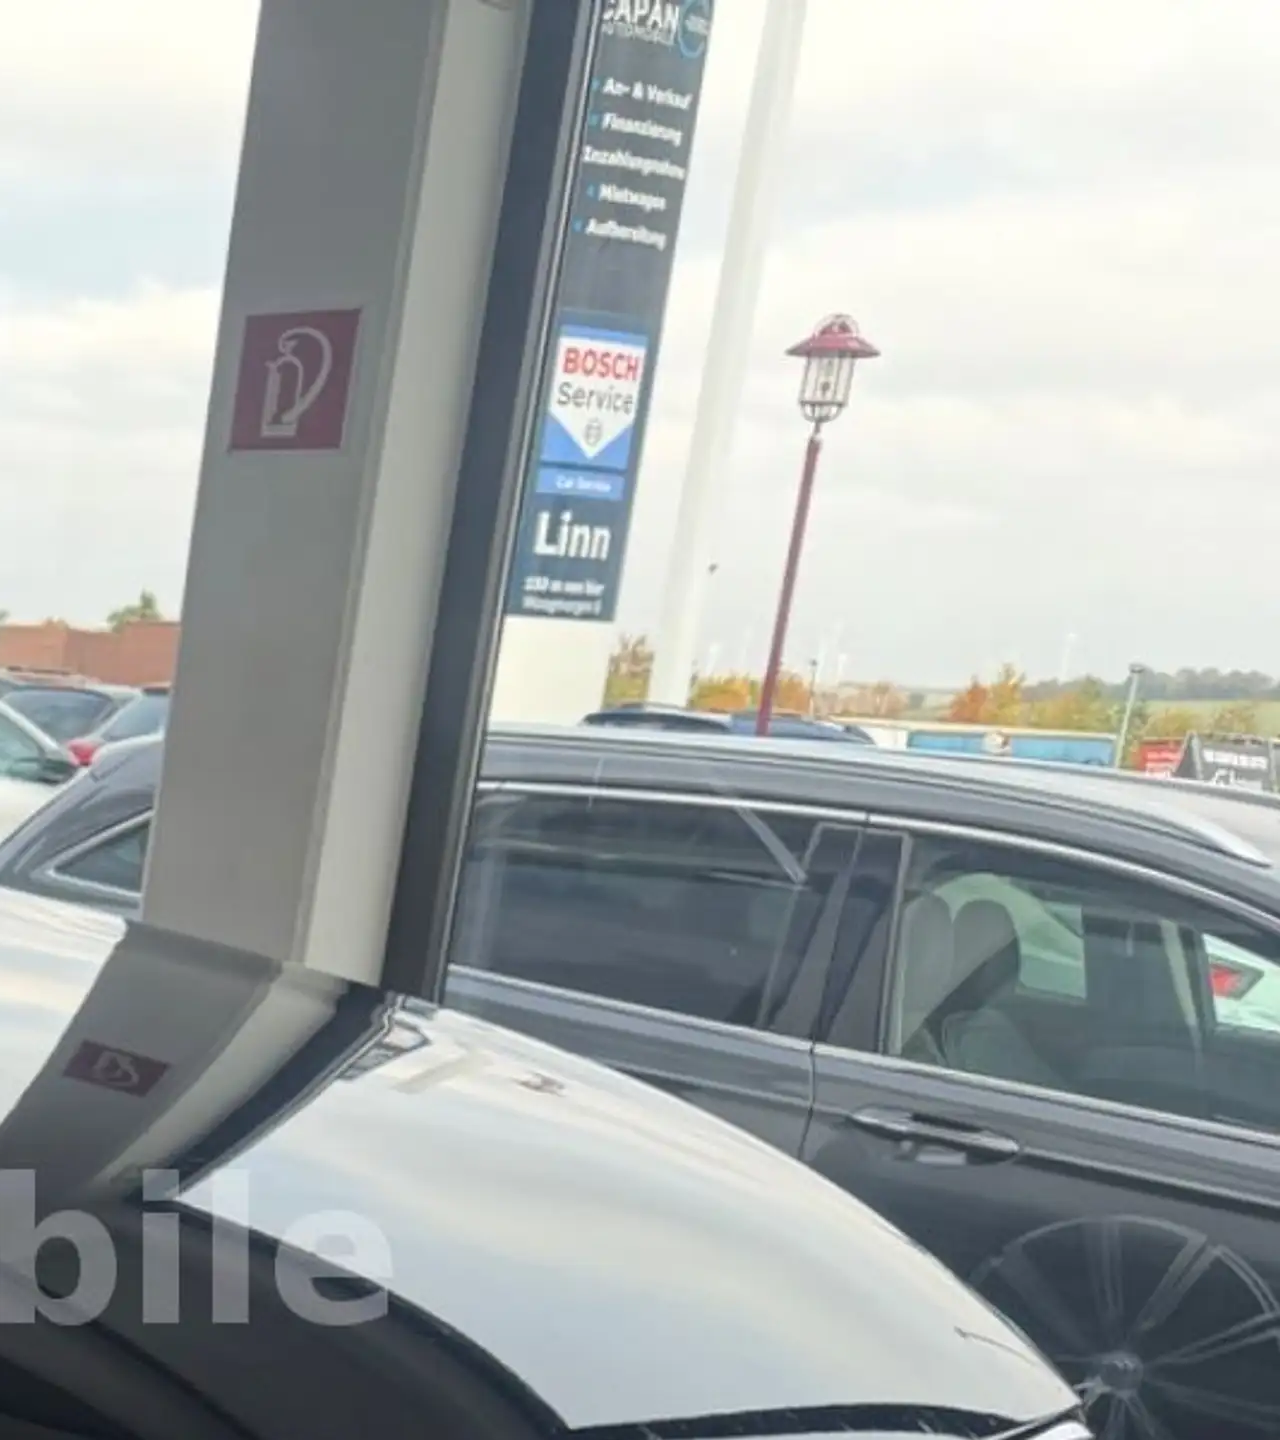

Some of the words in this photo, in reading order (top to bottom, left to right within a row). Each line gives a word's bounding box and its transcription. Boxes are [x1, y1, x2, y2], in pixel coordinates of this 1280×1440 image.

[561, 346, 639, 381] BOSCH
[556, 380, 634, 415] Service
[534, 509, 611, 562] Linn
